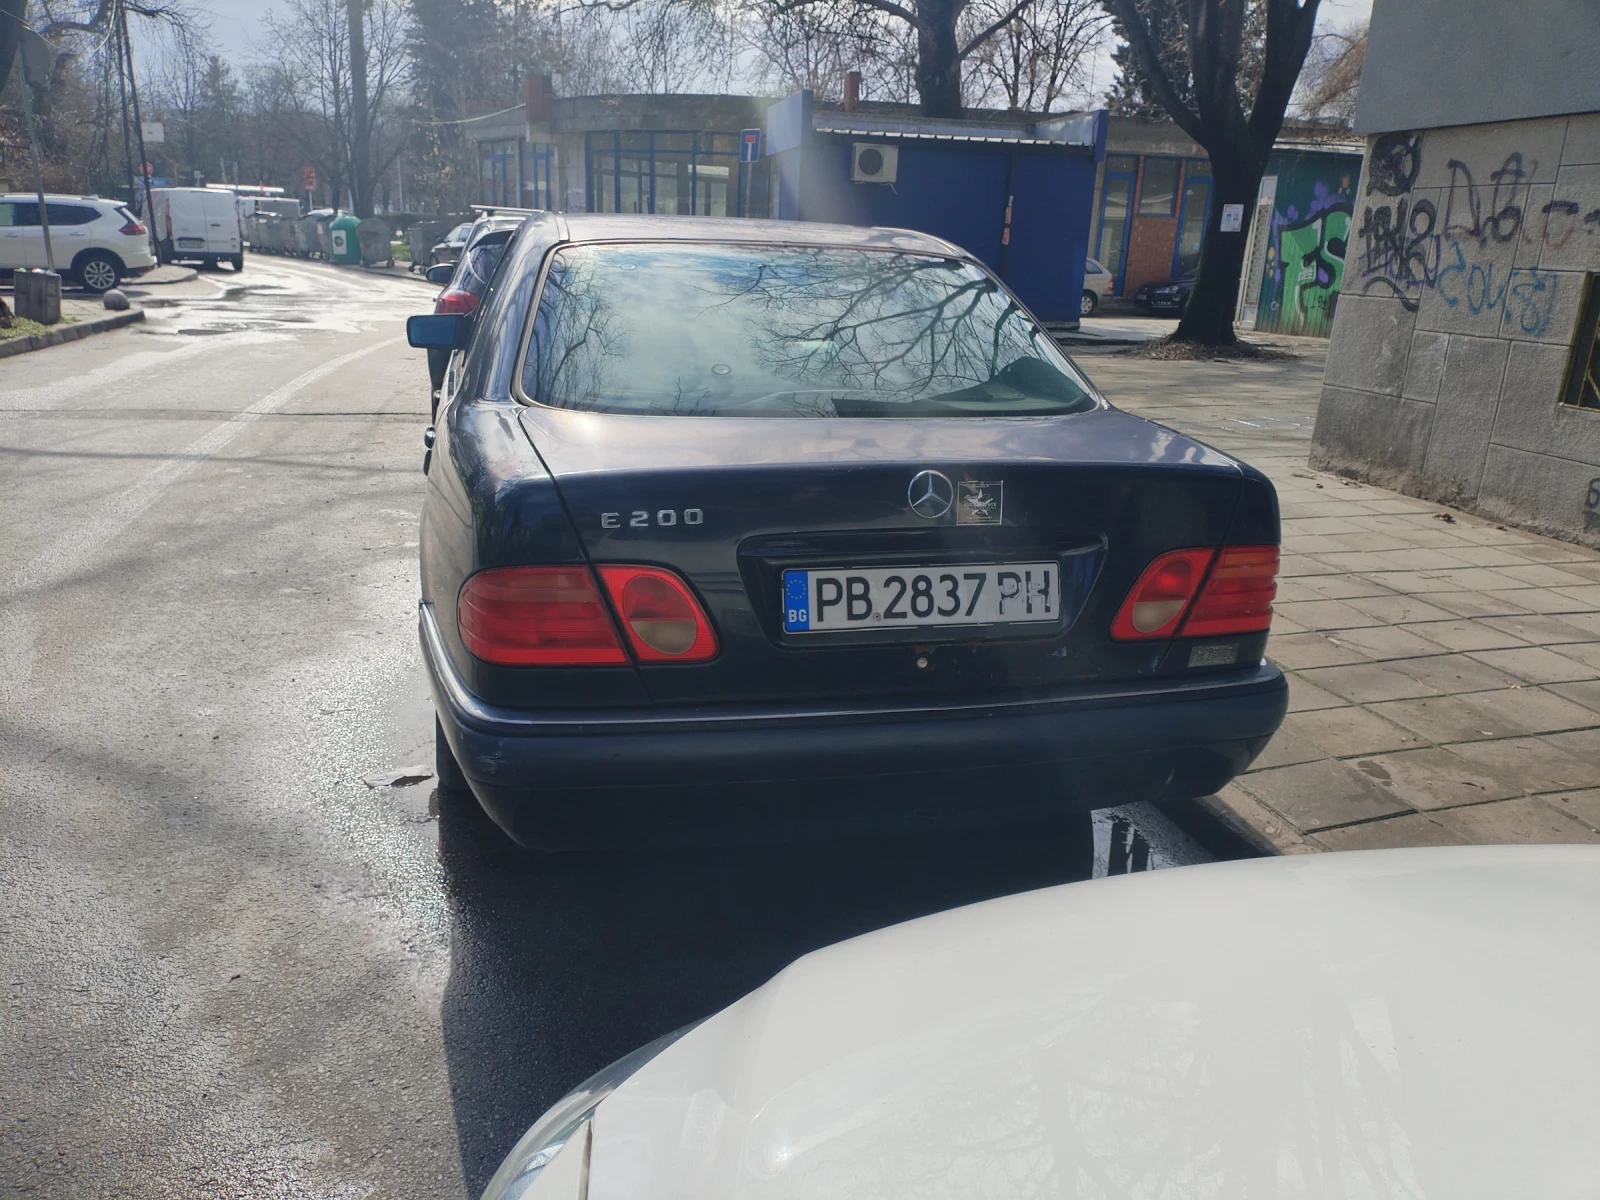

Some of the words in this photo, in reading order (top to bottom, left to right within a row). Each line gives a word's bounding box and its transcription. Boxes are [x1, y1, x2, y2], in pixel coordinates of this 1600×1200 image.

[601, 512, 621, 529] E
[629, 508, 704, 527] 200
[882, 572, 988, 620] 2837
[788, 609, 807, 623] BG
